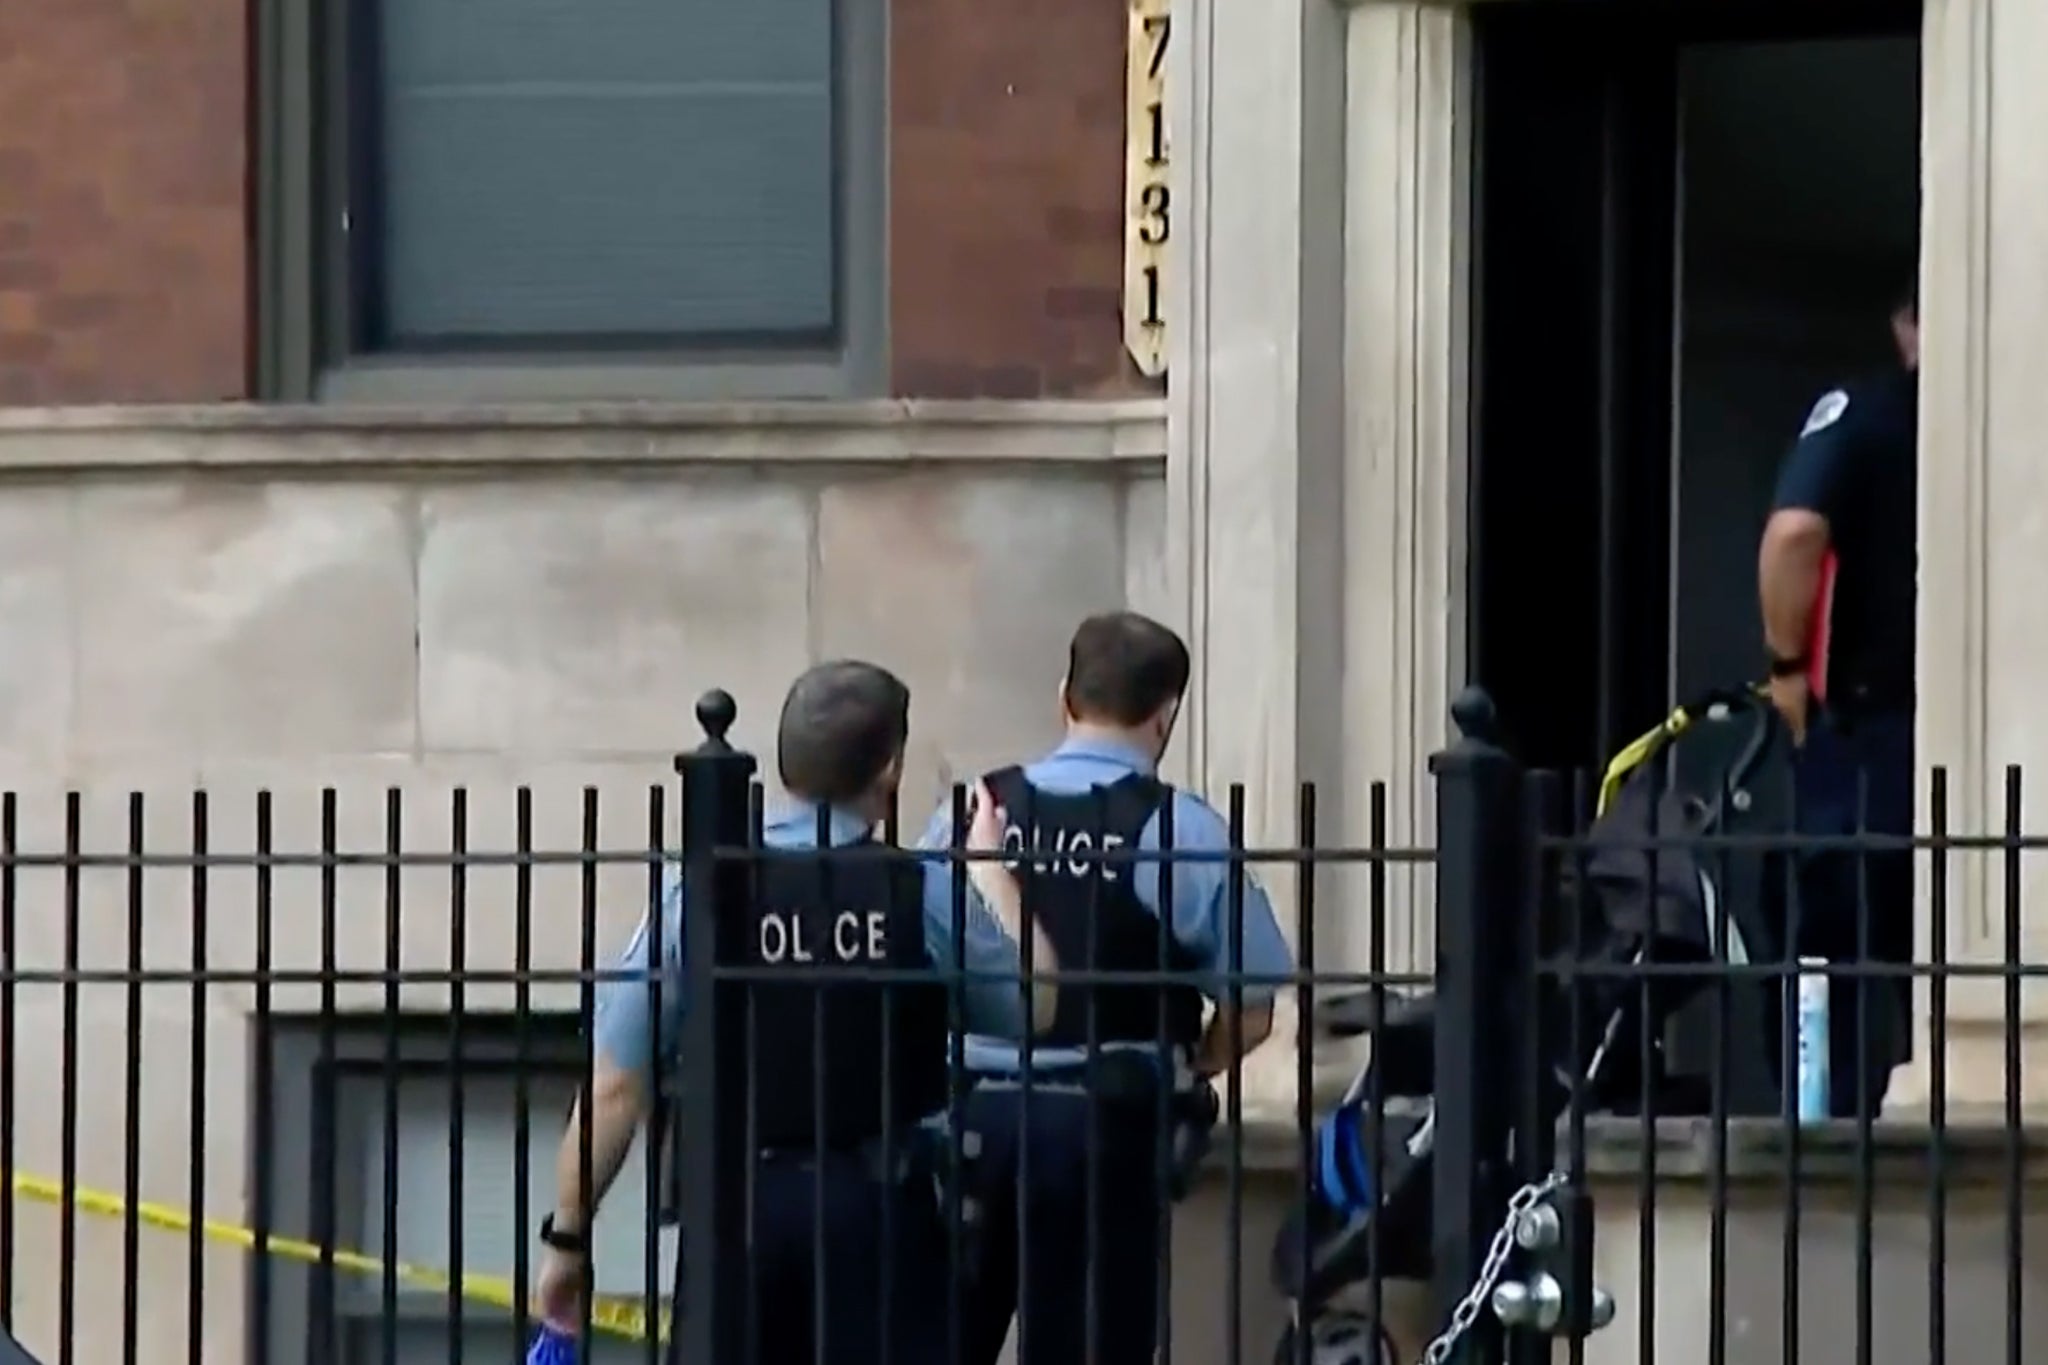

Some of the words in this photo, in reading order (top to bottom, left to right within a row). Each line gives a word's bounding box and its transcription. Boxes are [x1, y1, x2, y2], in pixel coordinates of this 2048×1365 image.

[1139, 13, 1171, 329] 7131
[1003, 823, 1124, 881] OLICE
[760, 911, 887, 964] OLCE
